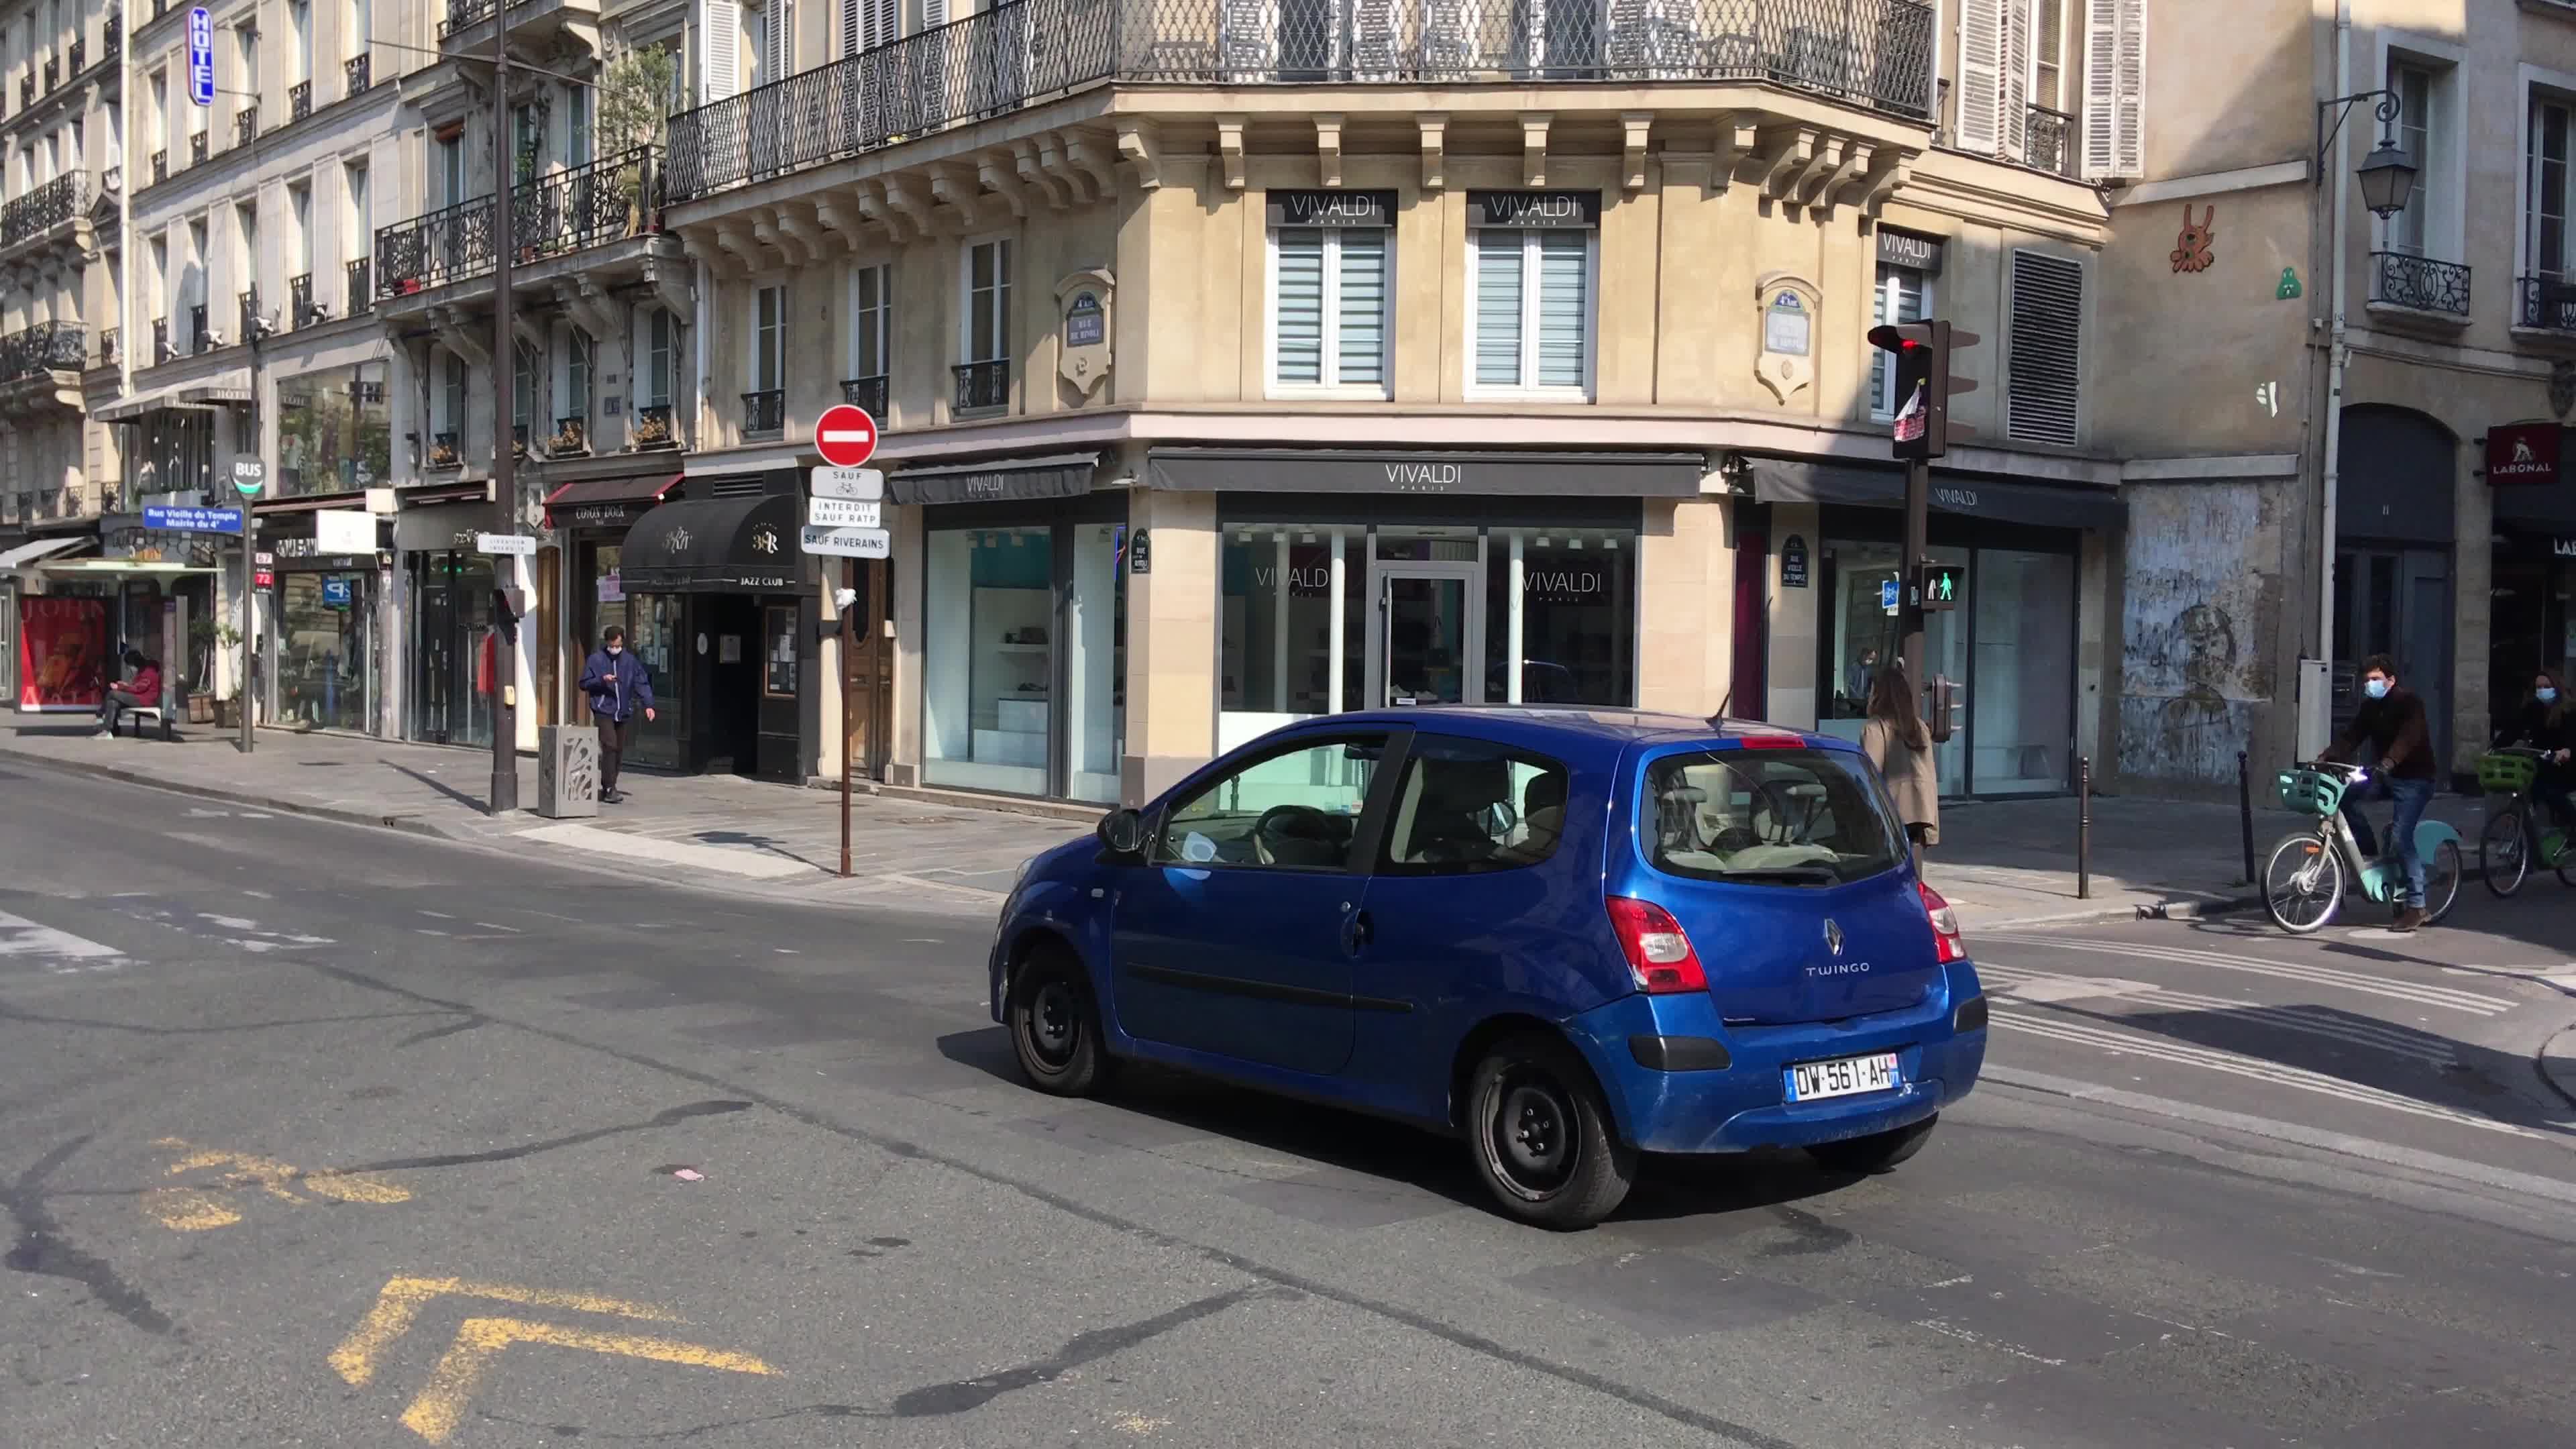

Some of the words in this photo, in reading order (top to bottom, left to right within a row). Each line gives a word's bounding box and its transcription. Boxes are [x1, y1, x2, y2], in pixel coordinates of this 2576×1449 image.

[193, 13, 211, 99] HOTEL
[1292, 195, 1376, 216] VIVALDI
[1491, 195, 1576, 217] VIVALDI
[1883, 233, 1931, 259] VIVALDI
[235, 462, 262, 477] BUS
[833, 471, 863, 480] SAUF
[1385, 464, 1461, 483] VIVALDI
[2493, 463, 2552, 474] LABONAL
[967, 474, 1004, 492] VIVALDI
[1935, 488, 1978, 506] VIVALDI
[148, 508, 164, 517] Rue
[166, 510, 193, 519] Vieille
[195, 511, 205, 519] du
[207, 511, 237, 521] Temple
[819, 502, 873, 513] INTERDIT
[166, 519, 195, 528] Mairie
[197, 520, 209, 528] du
[814, 513, 844, 521] SAUF
[849, 514, 876, 523] RATP
[804, 534, 830, 545] SAUF
[833, 537, 884, 549] RIVERAINS
[257, 553, 272, 564] 67
[257, 574, 271, 584] 72
[741, 577, 759, 586] JAZZ
[762, 578, 784, 586] CLUB
[1521, 572, 1601, 592] VIVALDI
[1805, 962, 1870, 977] TWINGO
